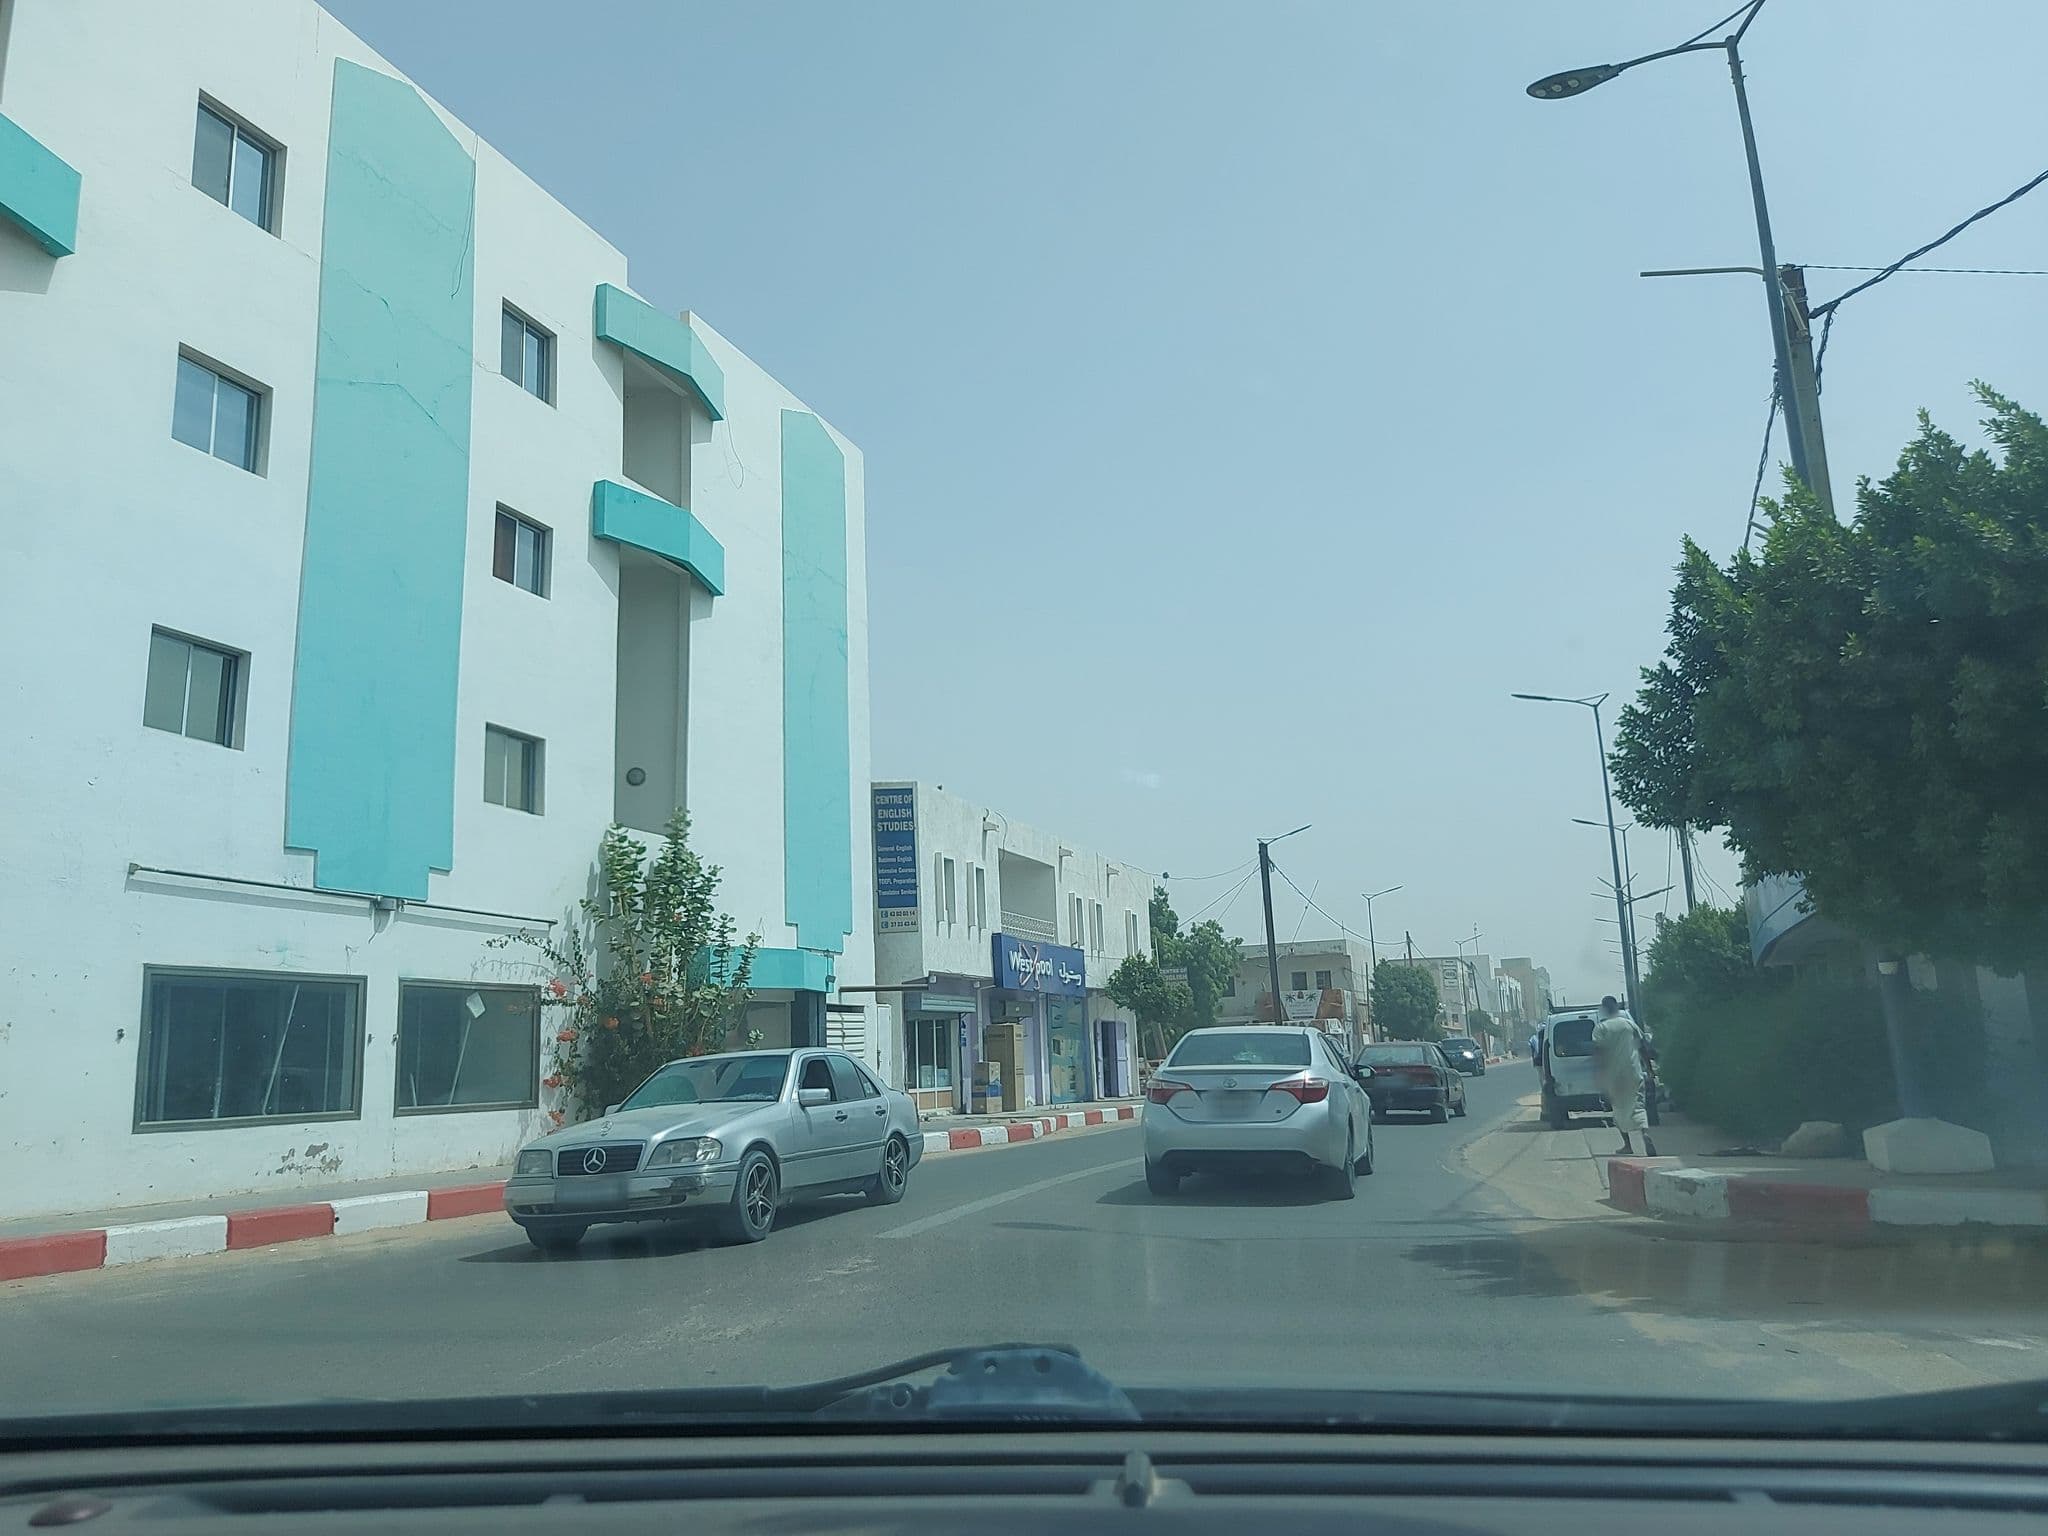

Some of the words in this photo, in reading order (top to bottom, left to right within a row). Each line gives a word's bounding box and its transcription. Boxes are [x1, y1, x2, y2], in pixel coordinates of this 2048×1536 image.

[875, 795, 903, 804] CENTRE
[904, 795, 913, 804] OF
[878, 808, 912, 818] ENGLISH
[877, 821, 914, 831] STUDIES
